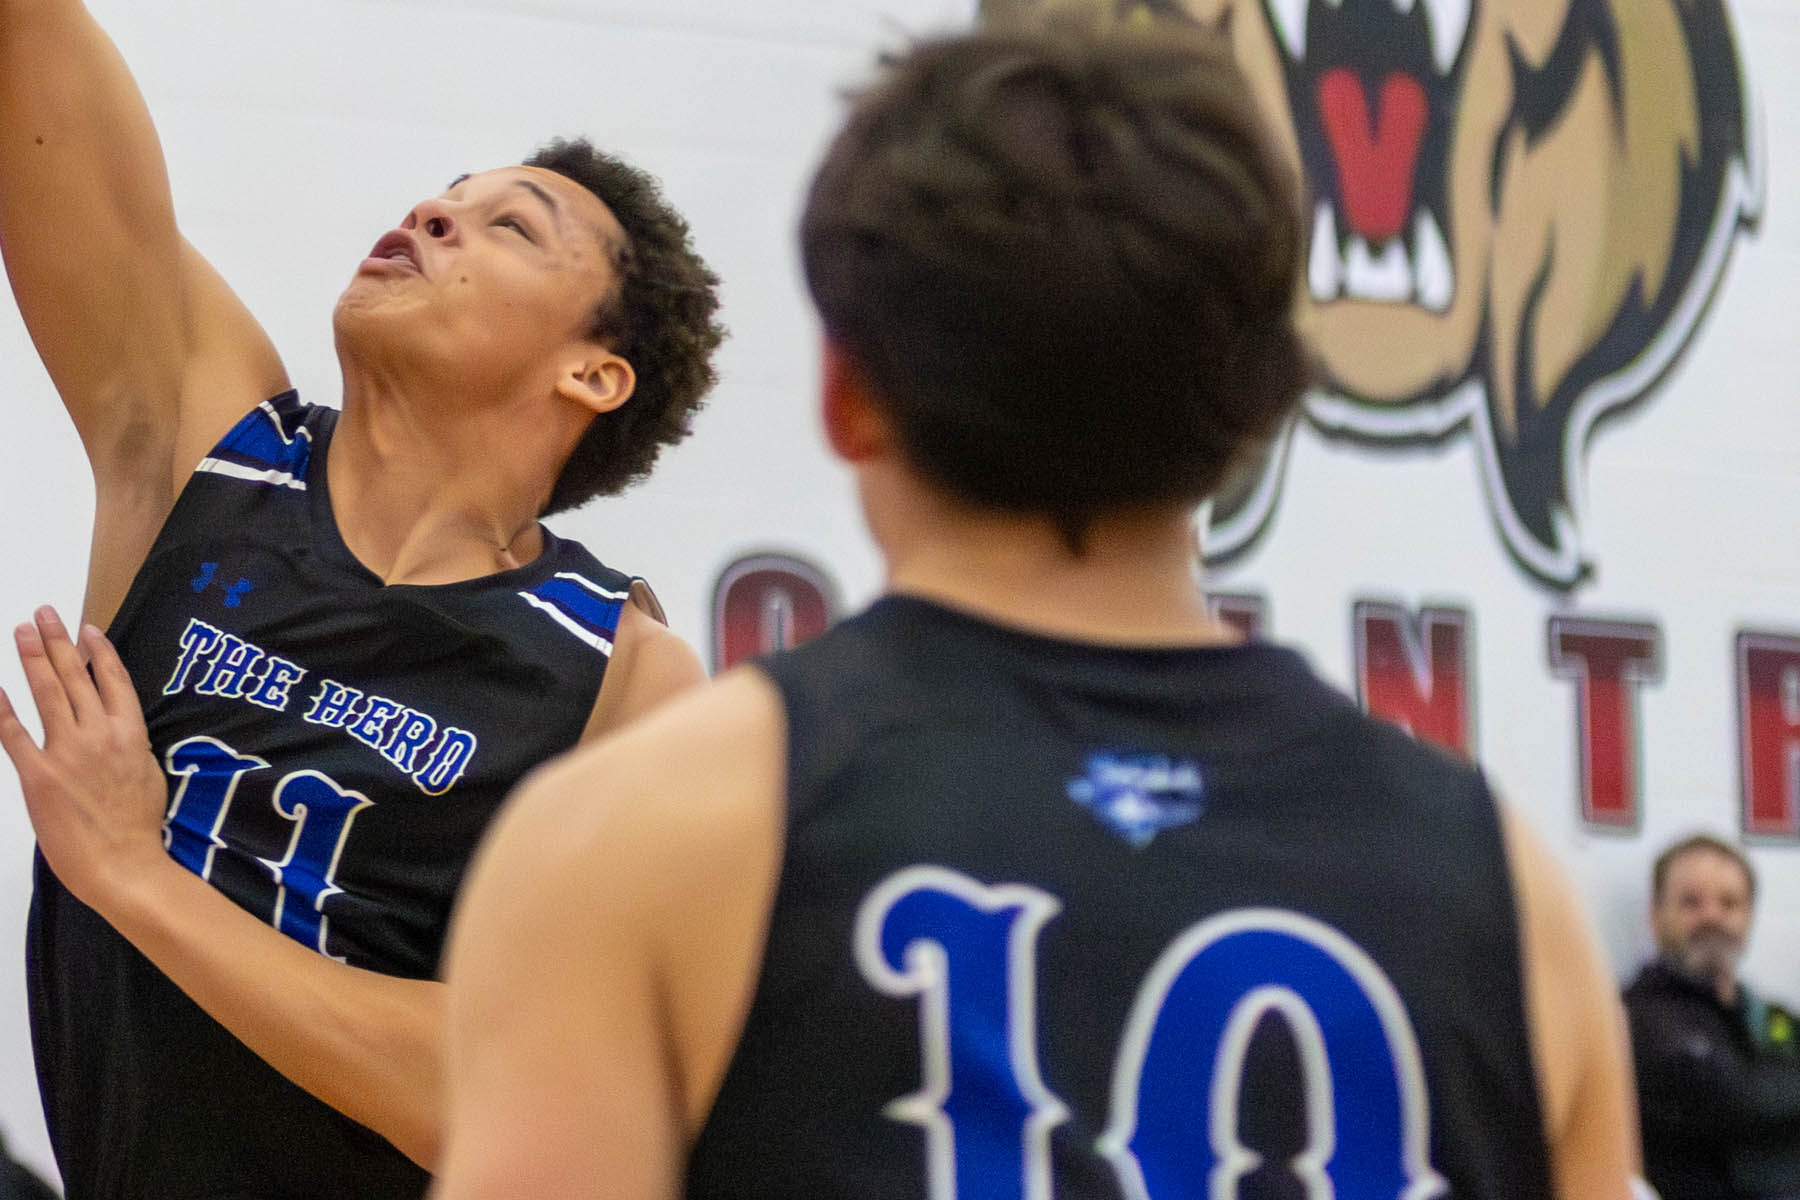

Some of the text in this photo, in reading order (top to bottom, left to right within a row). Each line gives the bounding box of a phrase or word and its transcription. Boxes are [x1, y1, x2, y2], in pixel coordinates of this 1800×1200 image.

[162, 617, 478, 797] THE HERD
[162, 735, 376, 964] 11
[854, 863, 1452, 1200] 10
